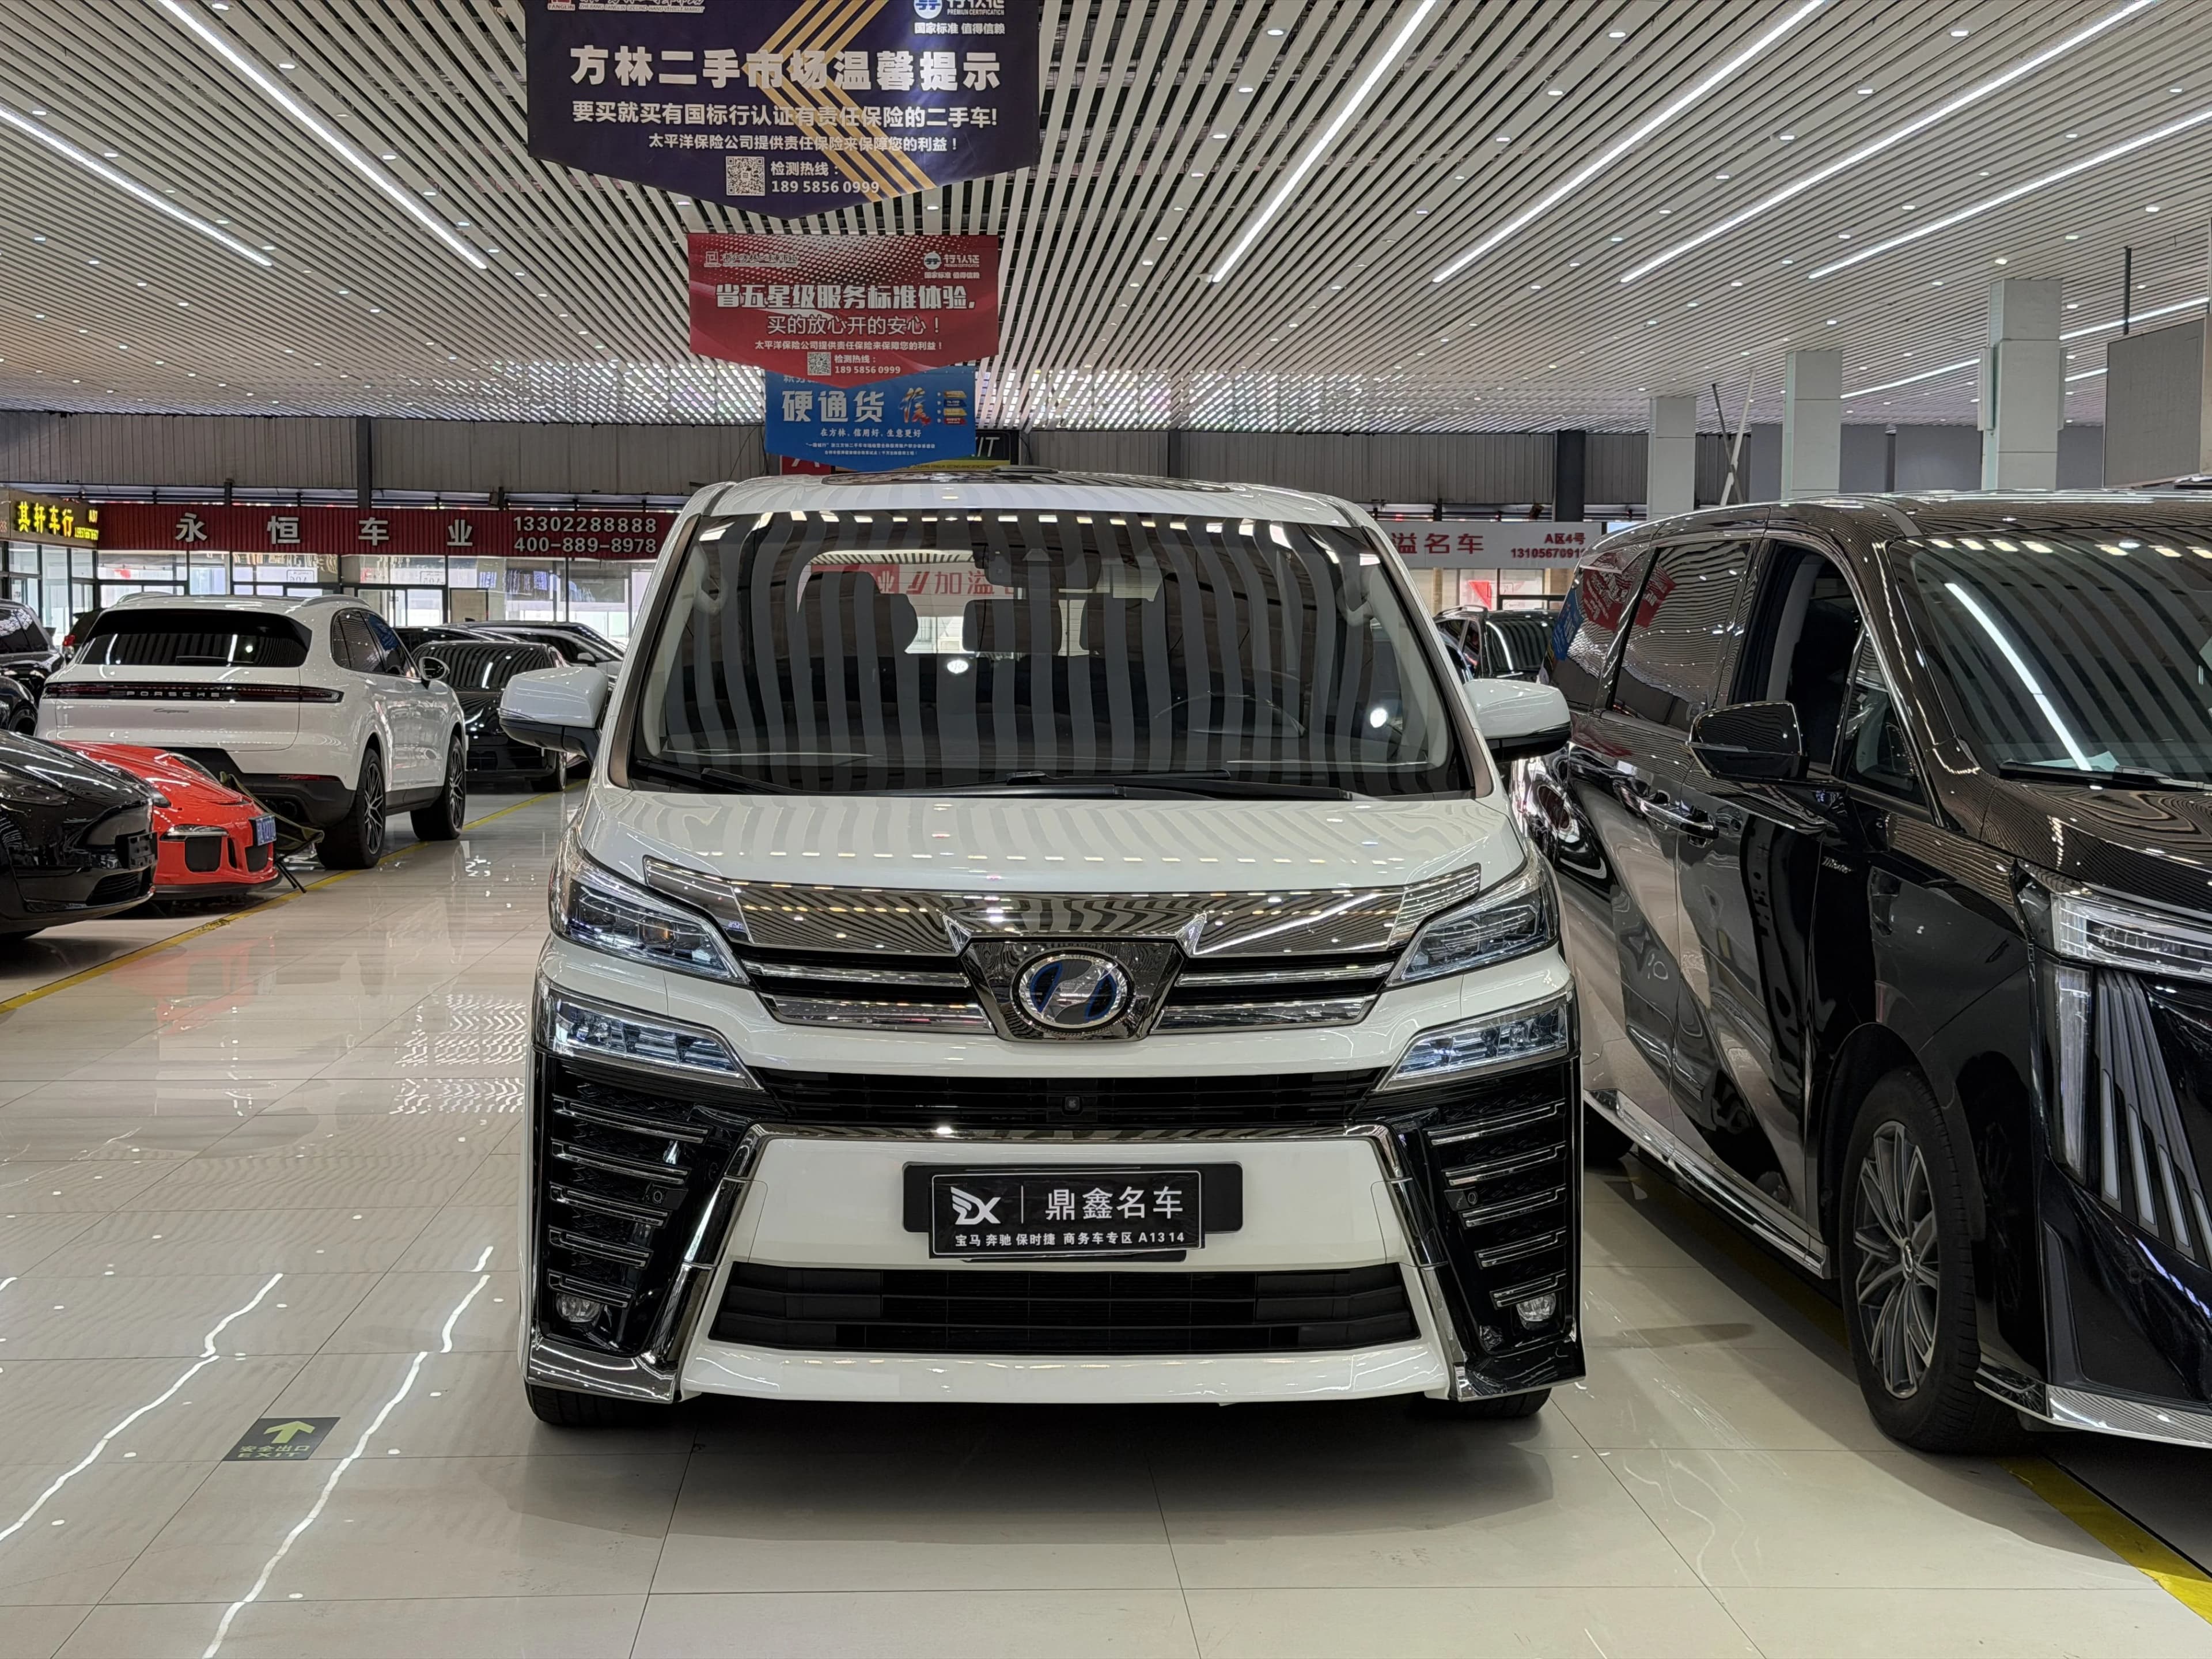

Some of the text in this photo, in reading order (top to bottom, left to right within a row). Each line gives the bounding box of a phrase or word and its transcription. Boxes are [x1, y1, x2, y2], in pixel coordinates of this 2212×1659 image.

[914, 22, 1005, 35] 国家标准 值得信赖
[570, 45, 1001, 90] 方林二手市场温馨提示
[771, 180, 880, 194] 189 5856 0999
[944, 254, 980, 264] 行认证
[835, 366, 901, 374] 189 5856 0999
[782, 390, 885, 423] 硬通货
[175, 513, 473, 547] 永恒车业
[514, 517, 657, 533] 13302288888
[514, 537, 657, 554] 400-889-8978
[1544, 532, 1586, 545] A区4号
[1045, 1185, 1184, 1221] 鼎鑫名车
[955, 1232, 1185, 1247] 宝马 奔驰 保时捷 商务车专区 A1314
